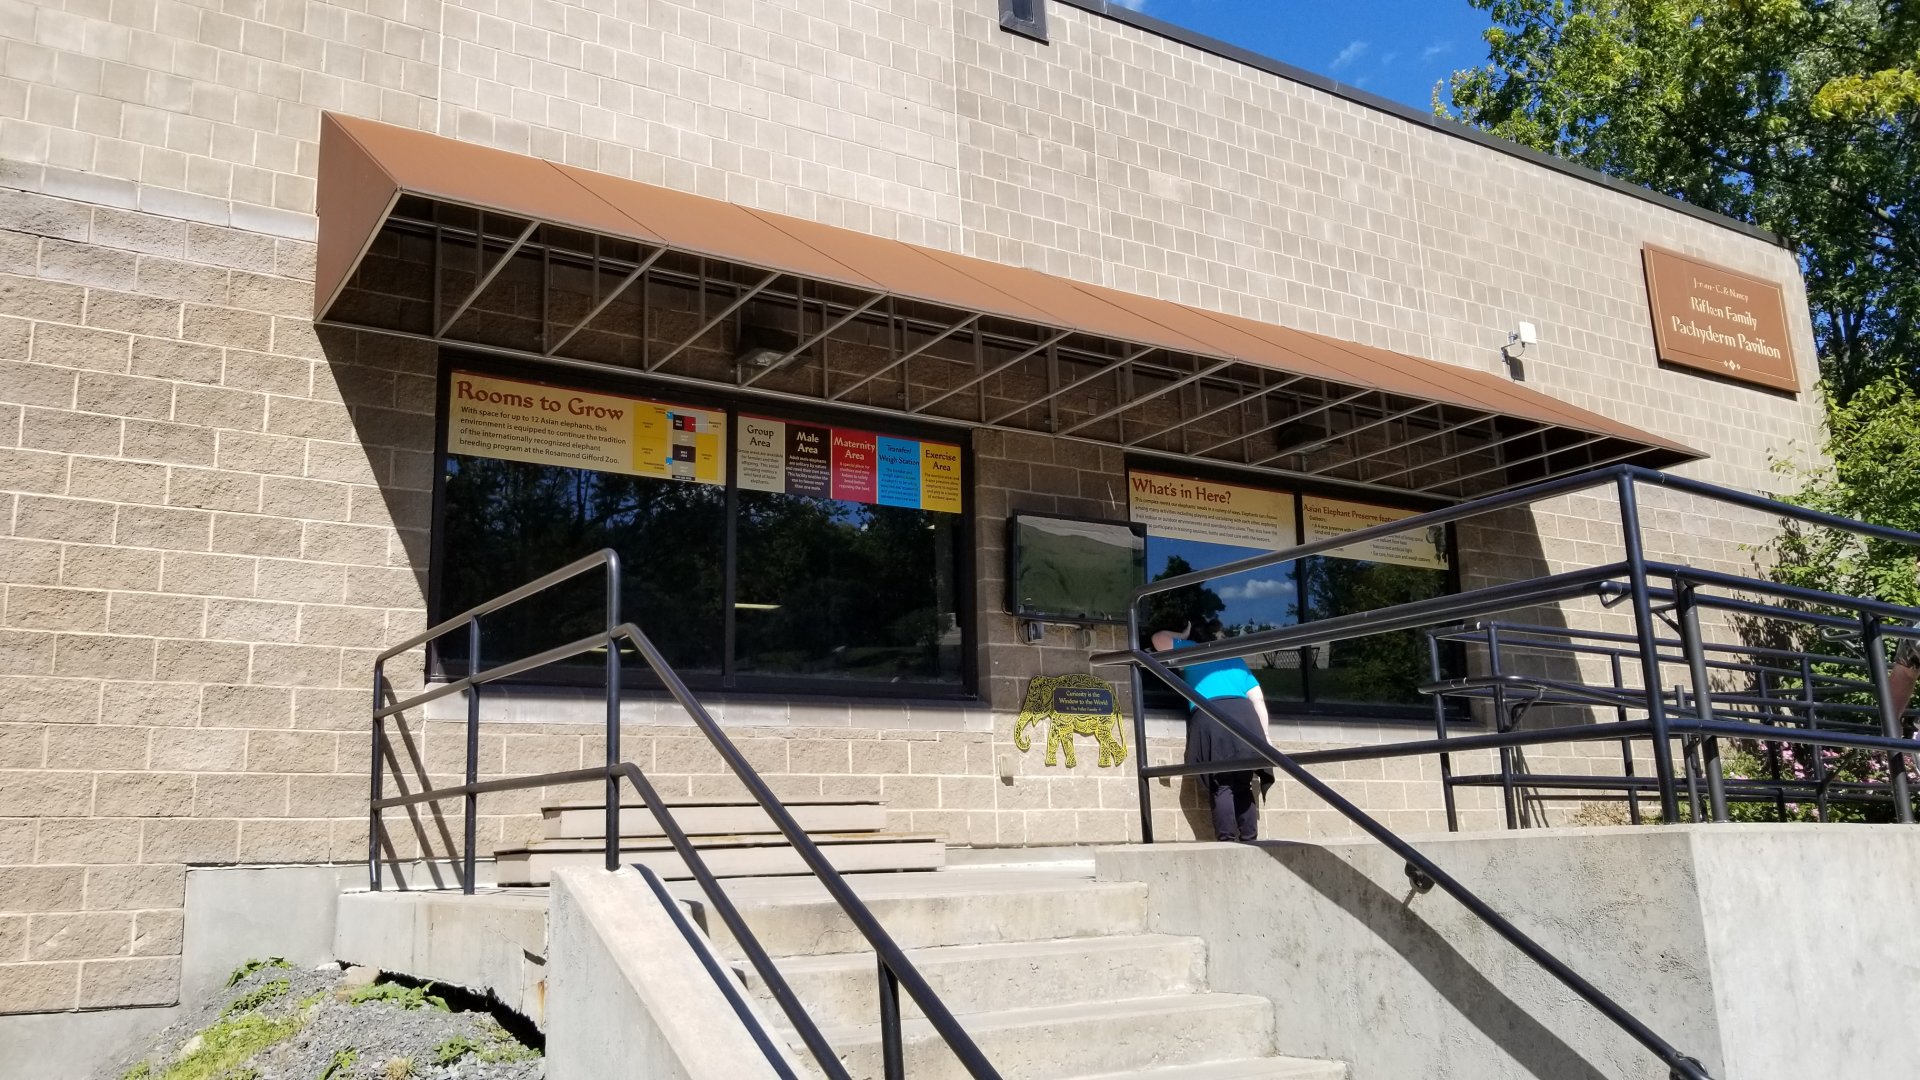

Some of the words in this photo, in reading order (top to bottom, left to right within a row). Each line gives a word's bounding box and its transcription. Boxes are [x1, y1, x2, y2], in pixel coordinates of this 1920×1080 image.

[1730, 288, 1749, 303] Nancy
[1725, 306, 1757, 331] Family
[1672, 315, 1736, 348] Pachyderm
[1737, 333, 1781, 360] Pavilion
[457, 381, 534, 408] Rooms
[540, 396, 561, 412] to
[568, 397, 623, 420] Grow
[461, 406, 478, 414] With
[480, 410, 499, 418] space
[501, 411, 511, 419] for
[511, 414, 521, 422] up
[541, 417, 559, 426] Asian
[560, 420, 594, 431] elephants,
[460, 417, 505, 429] environment
[514, 425, 546, 435] equipped
[548, 428, 555, 436] to
[556, 431, 586, 439] continue
[599, 435, 627, 445] tradition
[747, 424, 774, 439] Group
[797, 431, 820, 443] Male
[483, 430, 533, 445] internationally
[534, 438, 571, 448] recognized
[572, 442, 601, 452] elephant
[750, 436, 771, 447] Area
[798, 443, 818, 454] Area
[834, 437, 876, 453] Maternity
[459, 438, 491, 449] breeding
[493, 444, 523, 452] program
[532, 447, 543, 455] the
[545, 449, 581, 459] Rosamond
[581, 453, 605, 462] Gifford
[845, 449, 865, 461] Area
[925, 449, 957, 462] Exercise
[879, 454, 898, 465] Weigh
[899, 457, 920, 466] Station
[933, 461, 951, 472] Area
[1132, 477, 1177, 497] What's
[1181, 483, 1192, 499] in
[1195, 486, 1231, 504] Here?
[1304, 504, 1321, 513] Asian
[1323, 506, 1350, 518] Elephant
[1352, 510, 1378, 521] Preserve
